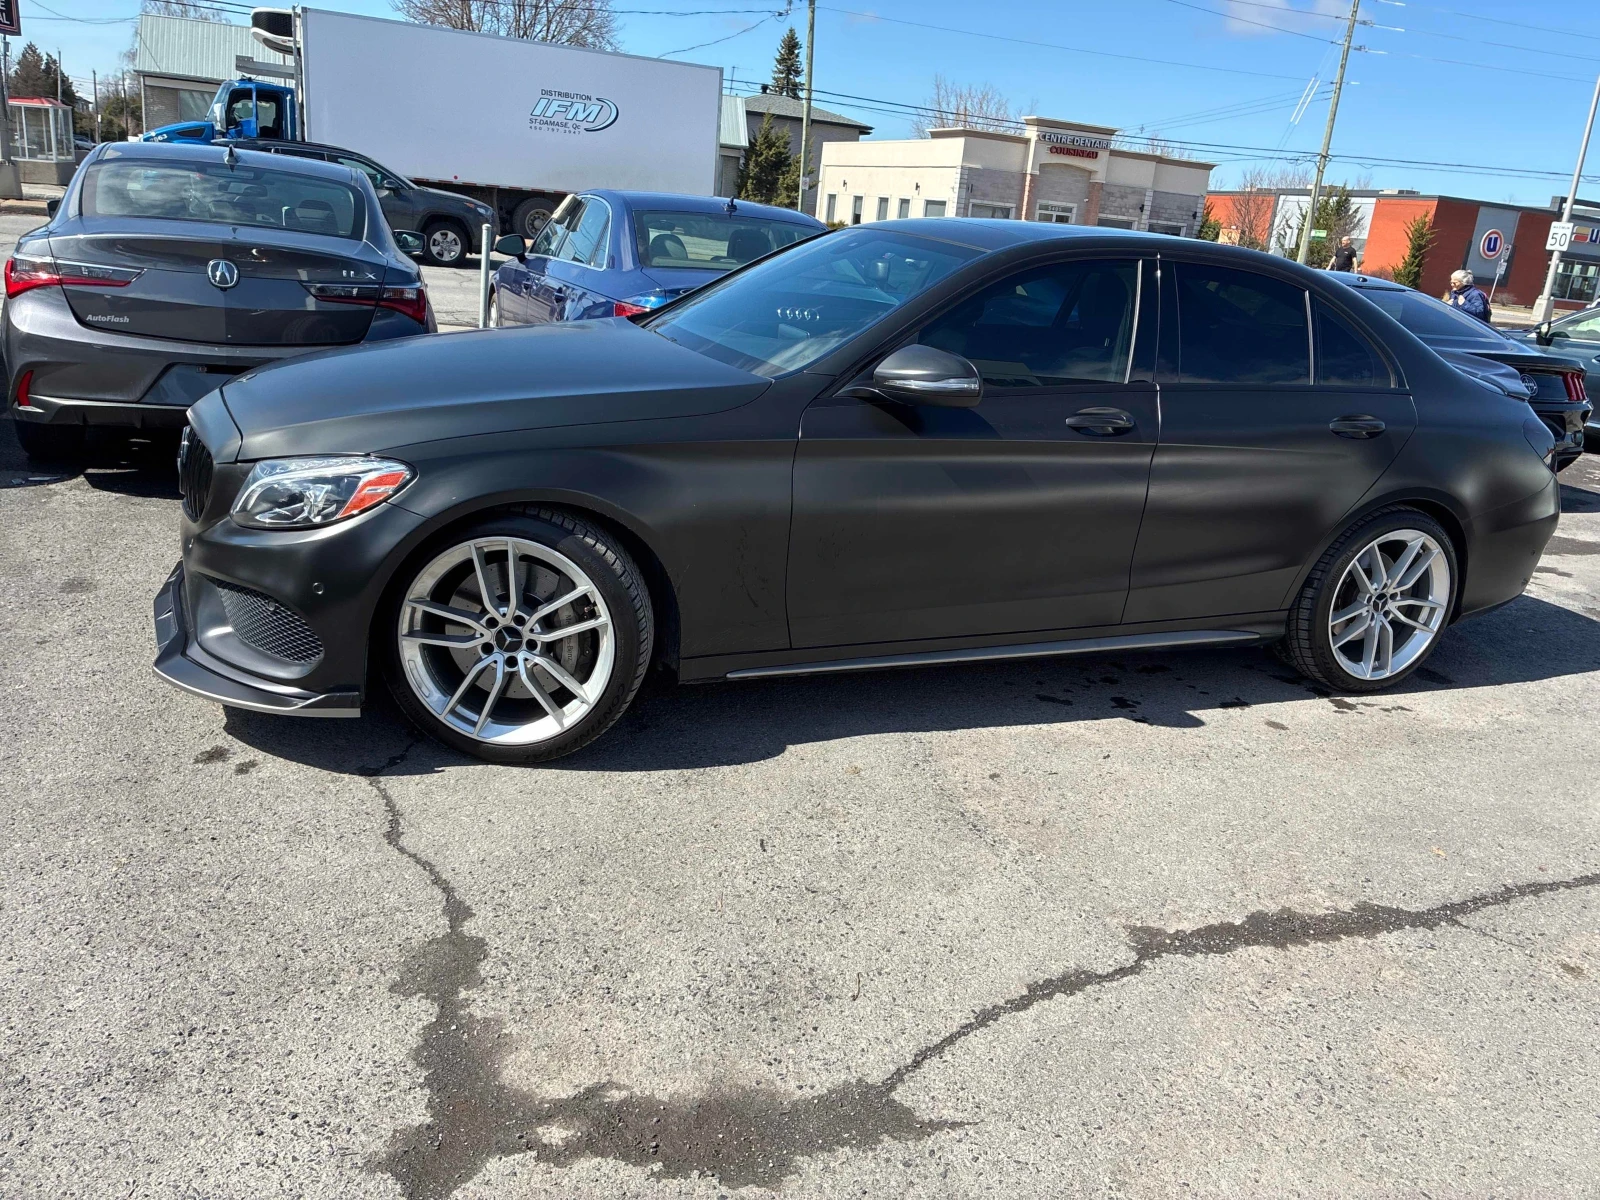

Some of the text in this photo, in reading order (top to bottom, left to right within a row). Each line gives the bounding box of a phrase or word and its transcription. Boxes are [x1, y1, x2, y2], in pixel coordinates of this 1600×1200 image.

[541, 89, 592, 101] DISTRIBUTION
[530, 97, 604, 123] IFM
[1039, 133, 1112, 149] CENTRE DENTAIRE
[1049, 145, 1099, 160] COUSINEAU
[1486, 236, 1498, 253] U
[1549, 232, 1567, 247] 50
[86, 314, 130, 323] AutoFlash
